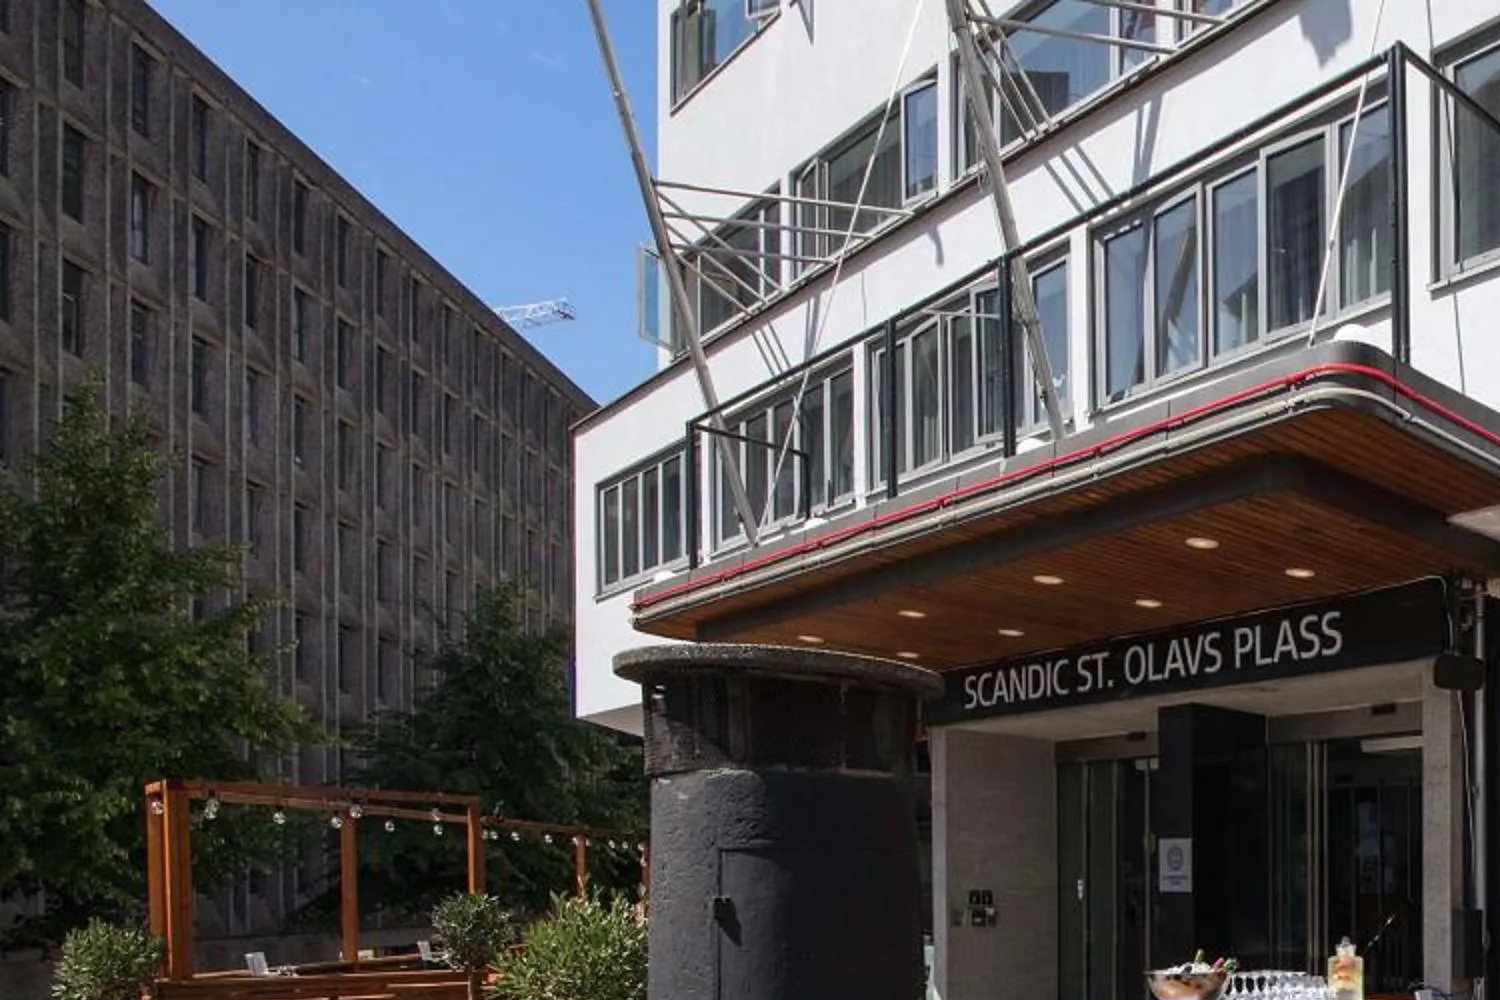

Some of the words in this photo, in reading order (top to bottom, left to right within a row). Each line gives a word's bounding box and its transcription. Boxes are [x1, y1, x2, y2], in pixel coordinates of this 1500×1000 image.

[963, 659, 1071, 709] SCANDIC
[1076, 651, 1114, 692] ST.
[1124, 631, 1223, 685] OLAVS
[1234, 611, 1343, 669] PLASS
